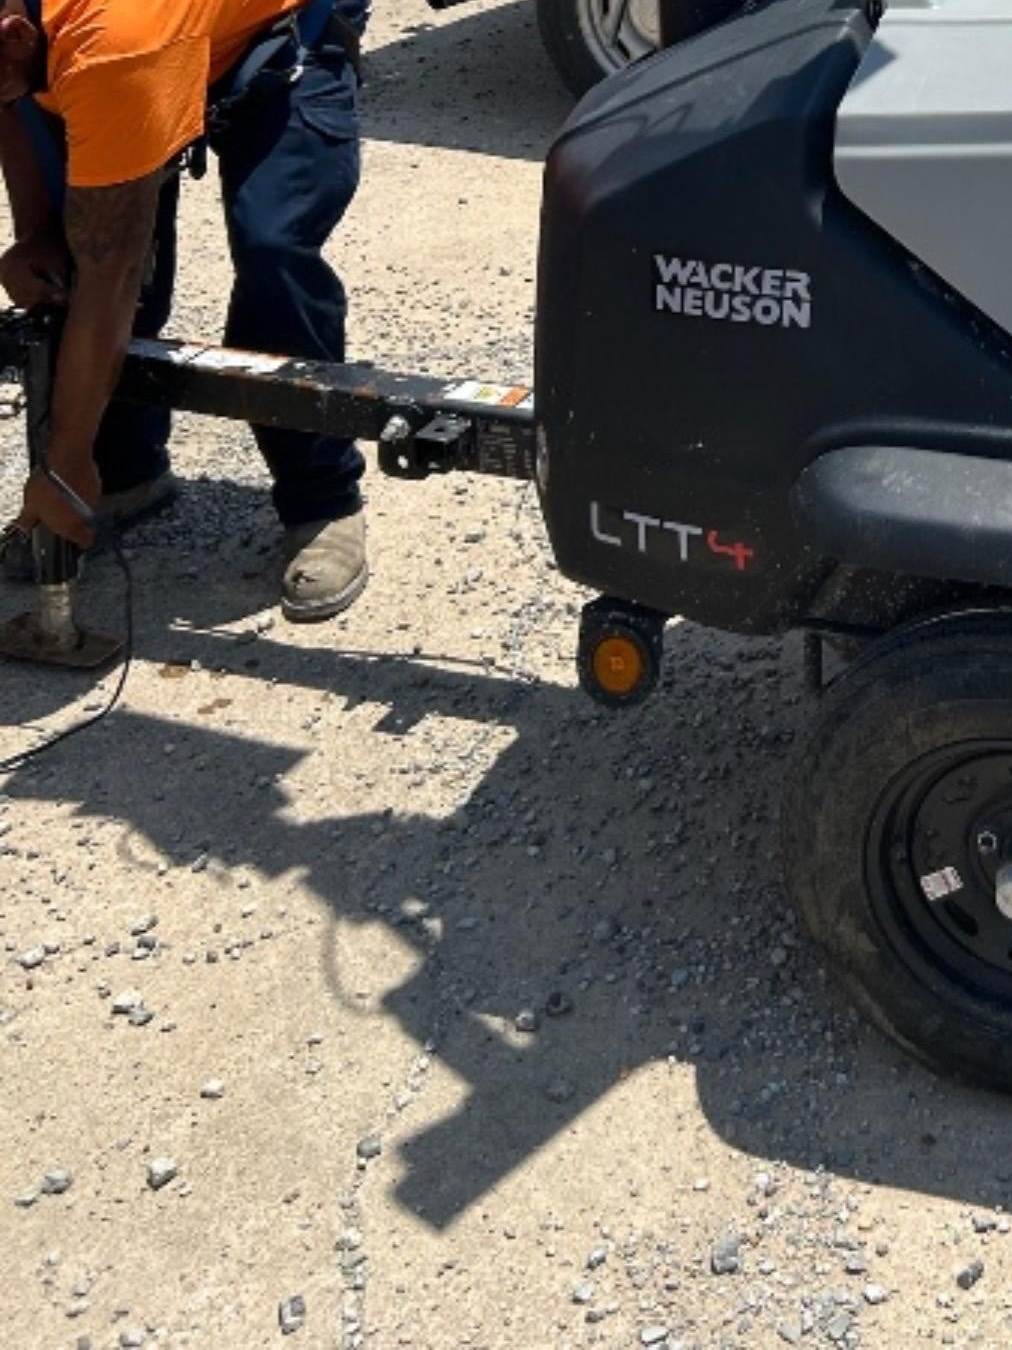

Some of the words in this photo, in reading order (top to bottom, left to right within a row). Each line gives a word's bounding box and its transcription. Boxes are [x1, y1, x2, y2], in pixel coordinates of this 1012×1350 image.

[654, 253, 812, 299] WACKER
[655, 284, 812, 328] NEUSON
[589, 500, 754, 571] LTT4
